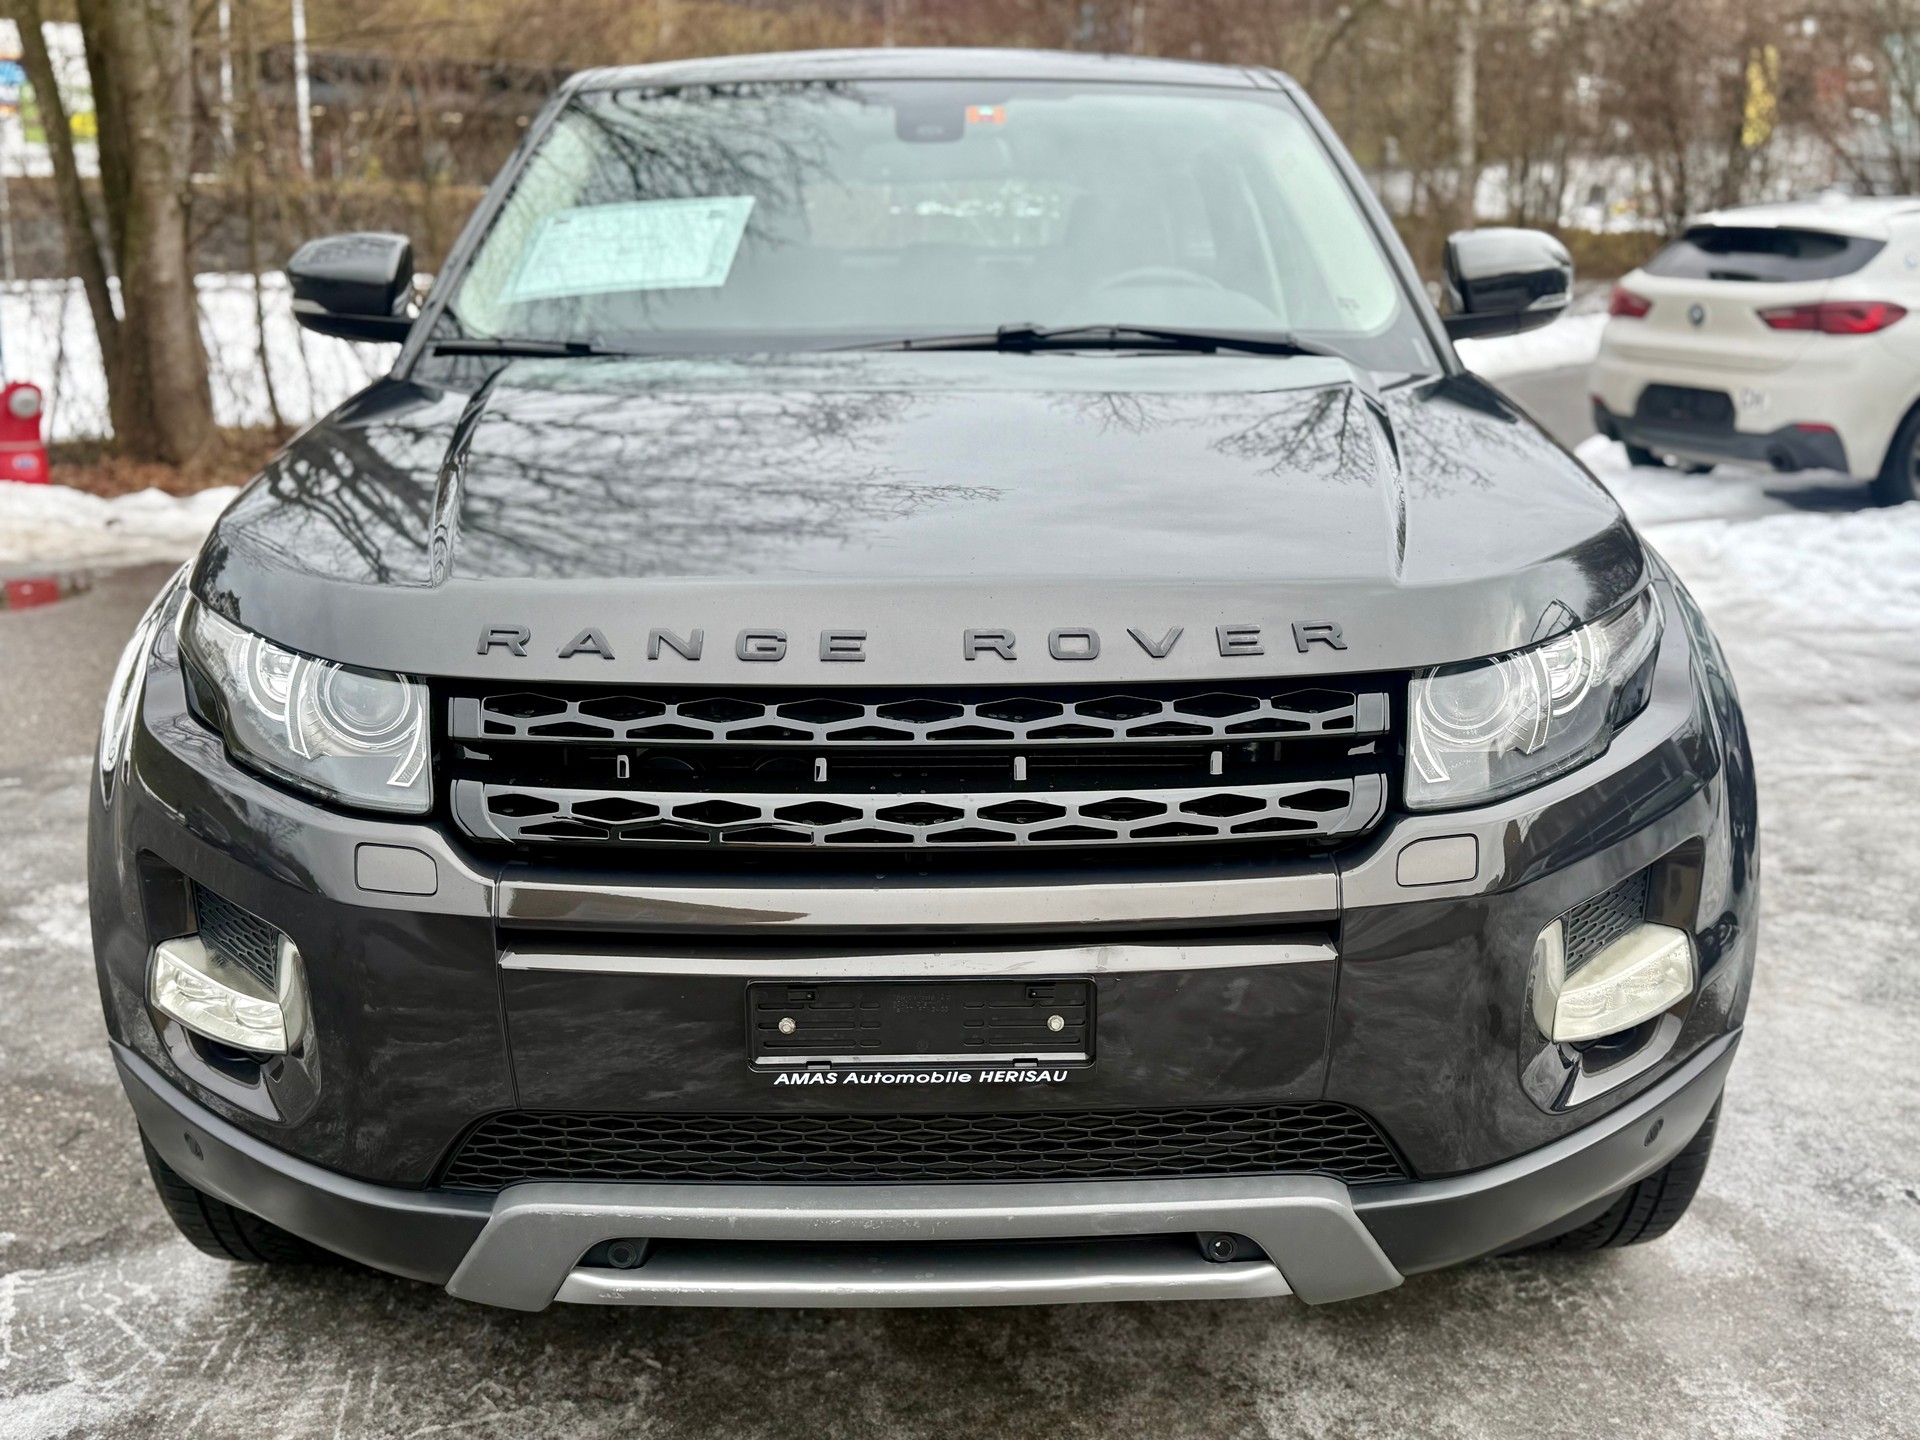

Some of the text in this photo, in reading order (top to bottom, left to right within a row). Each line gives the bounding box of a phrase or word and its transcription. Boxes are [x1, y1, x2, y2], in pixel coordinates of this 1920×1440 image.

[477, 620, 1348, 662] RANGE ROVER
[774, 1070, 1068, 1085] AMAS Automobile HERISAU
